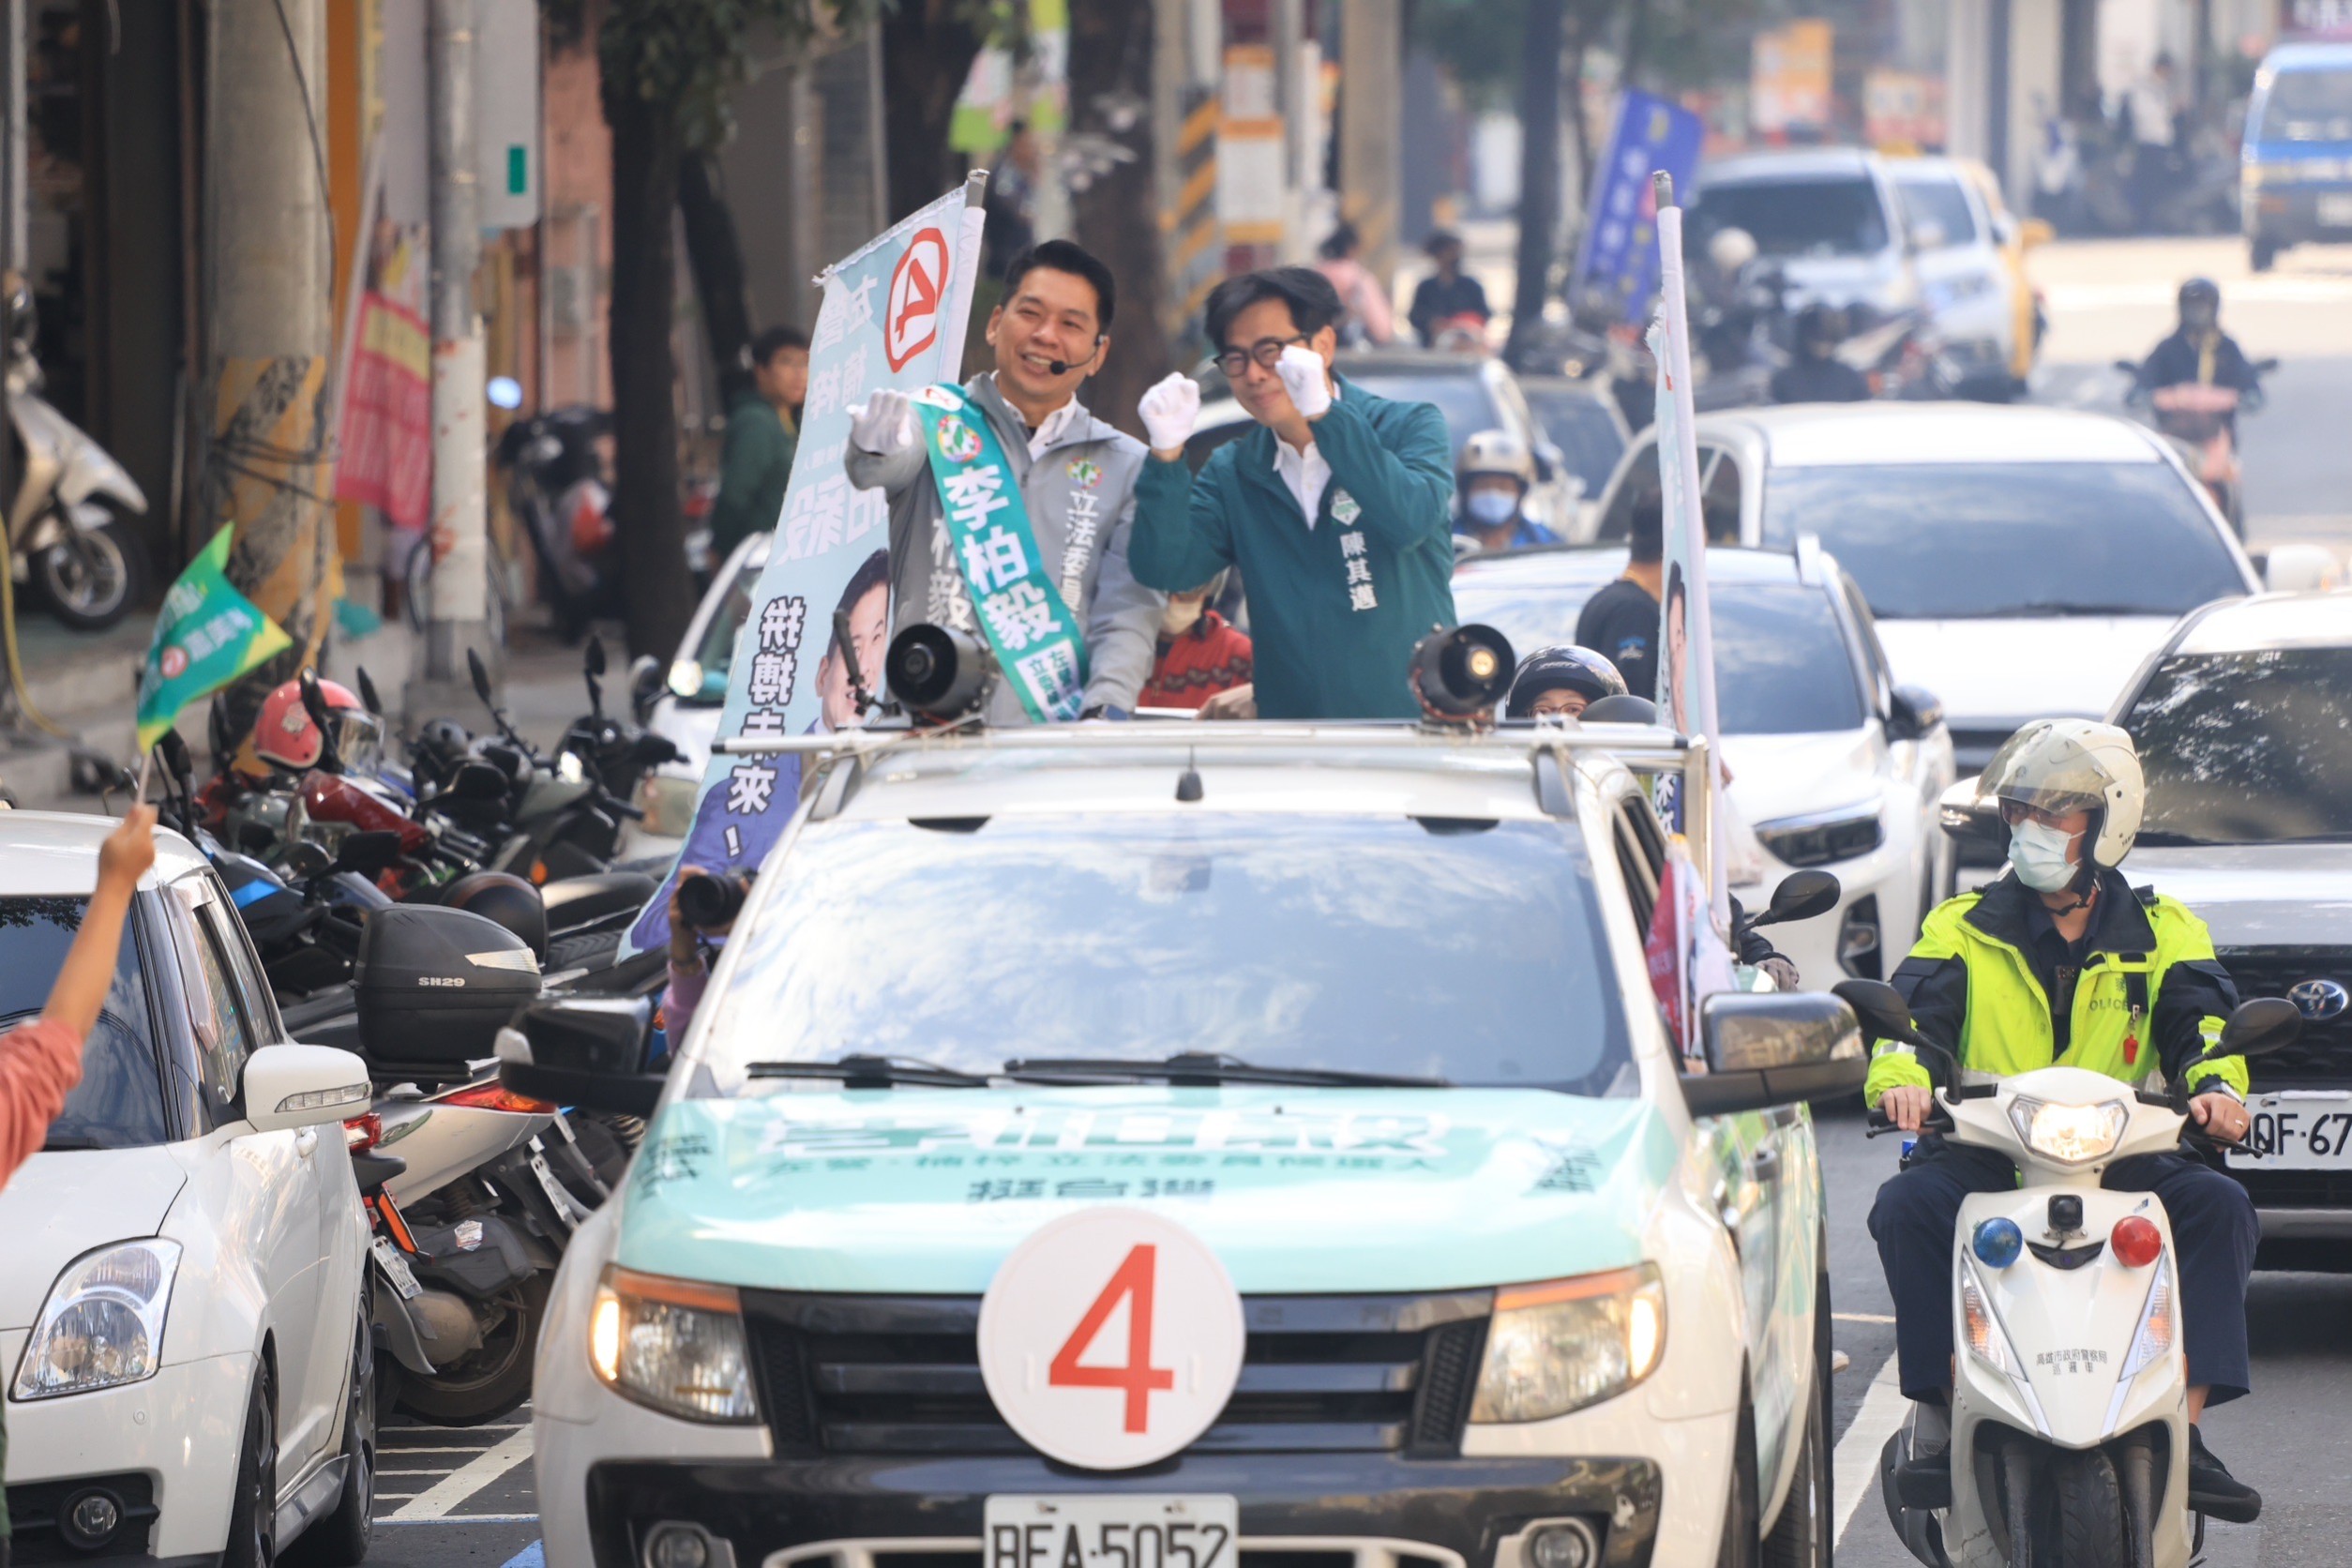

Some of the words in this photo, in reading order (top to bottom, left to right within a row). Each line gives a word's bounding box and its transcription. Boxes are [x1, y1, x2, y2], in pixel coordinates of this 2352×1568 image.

[943, 463, 1062, 650] 李柏毅
[1340, 531, 1378, 611] 陳其邁
[417, 976, 466, 988] SH29
[2089, 998, 2128, 1011] OLICE
[1048, 1242, 1174, 1434] 4
[2036, 1349, 2107, 1365] 高雄市政府警察局
